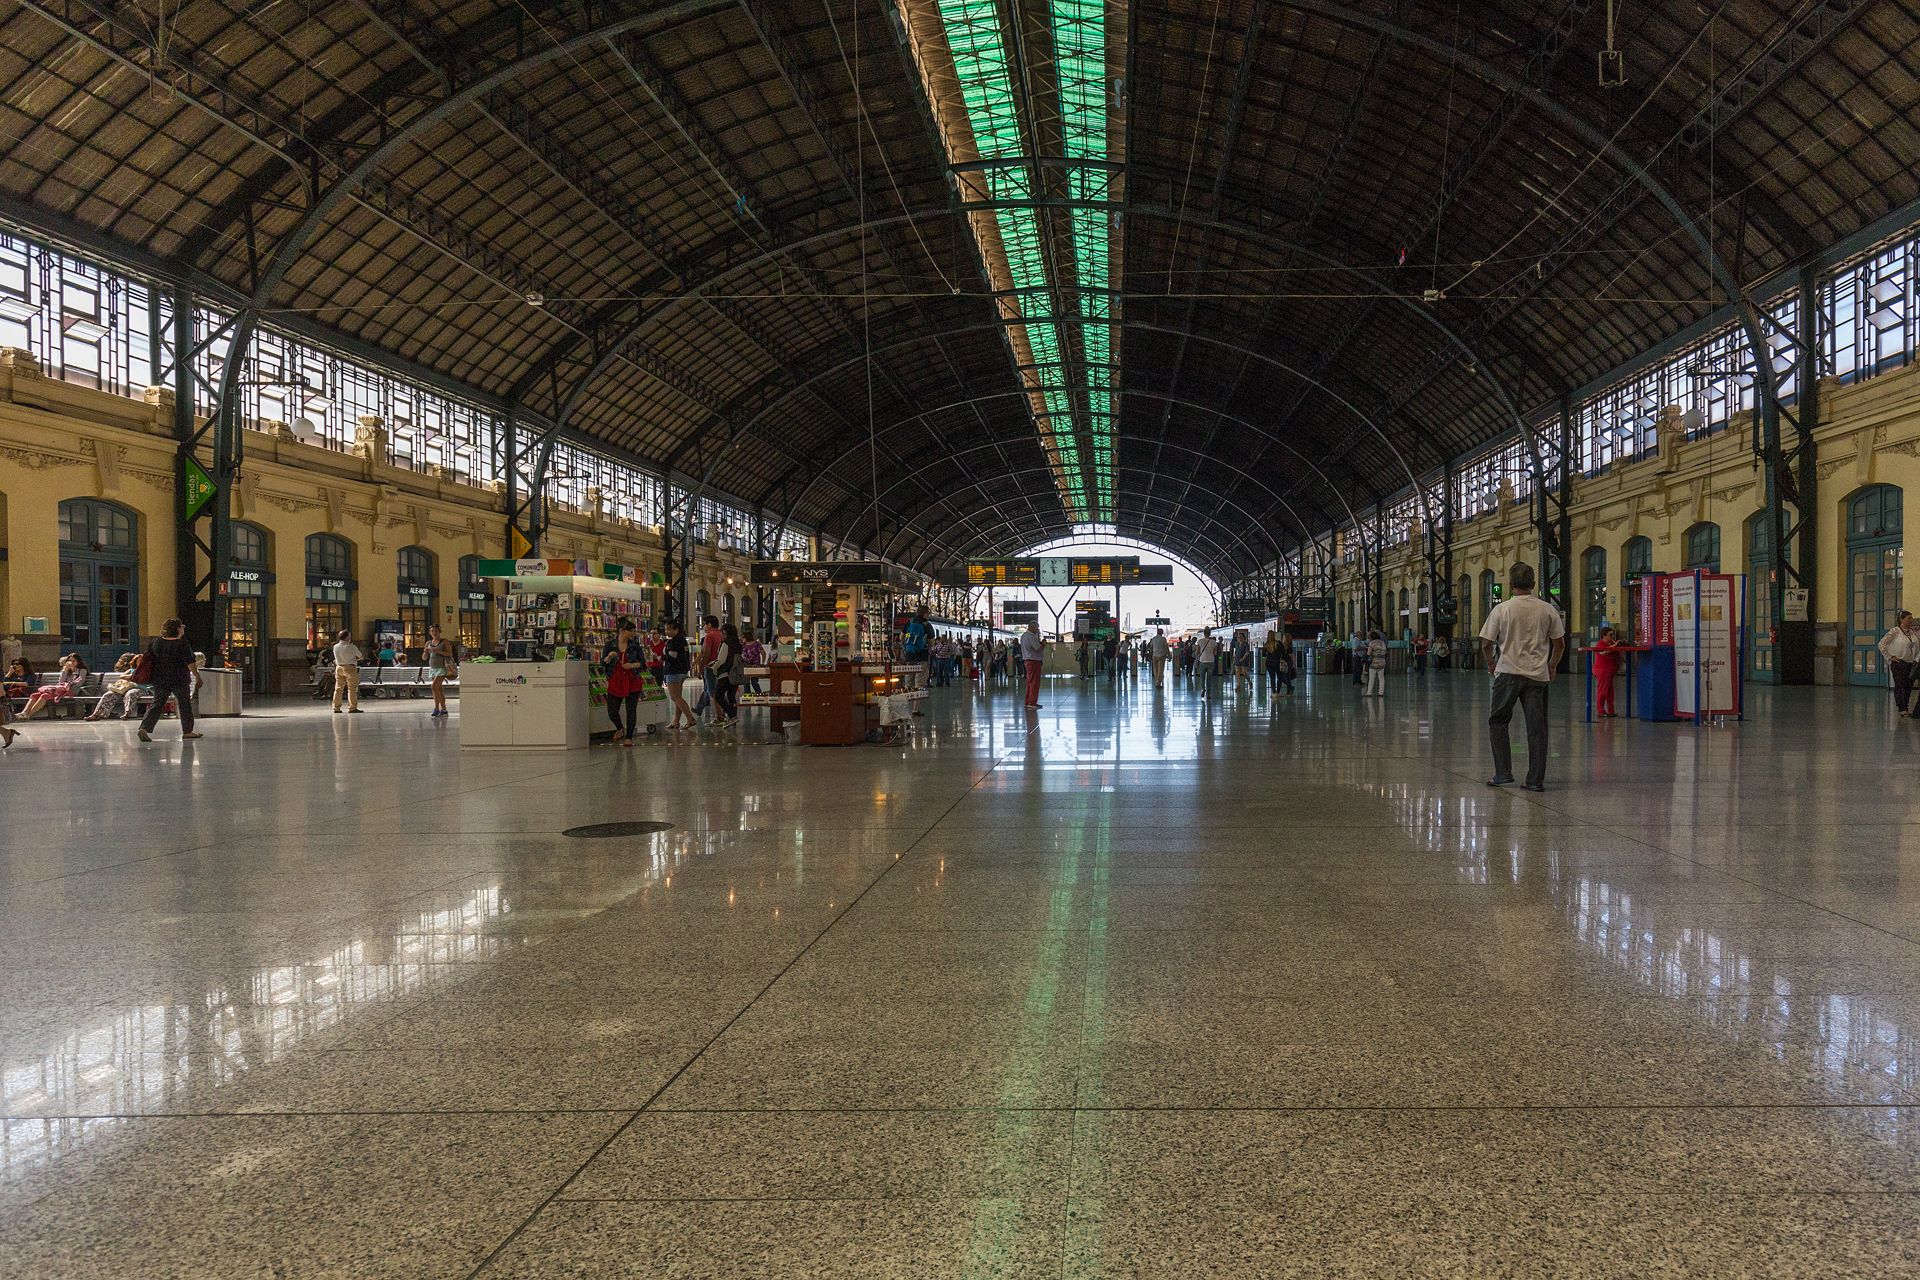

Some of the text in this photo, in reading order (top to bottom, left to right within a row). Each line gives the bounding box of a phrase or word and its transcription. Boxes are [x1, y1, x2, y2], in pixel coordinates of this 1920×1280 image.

[187, 474, 196, 505] tiendas
[230, 571, 259, 581] ALE-HOP
[321, 579, 345, 588] ALE-HOP
[409, 587, 429, 595] ALE-HOP
[1661, 579, 1670, 643] bancopopular-e
